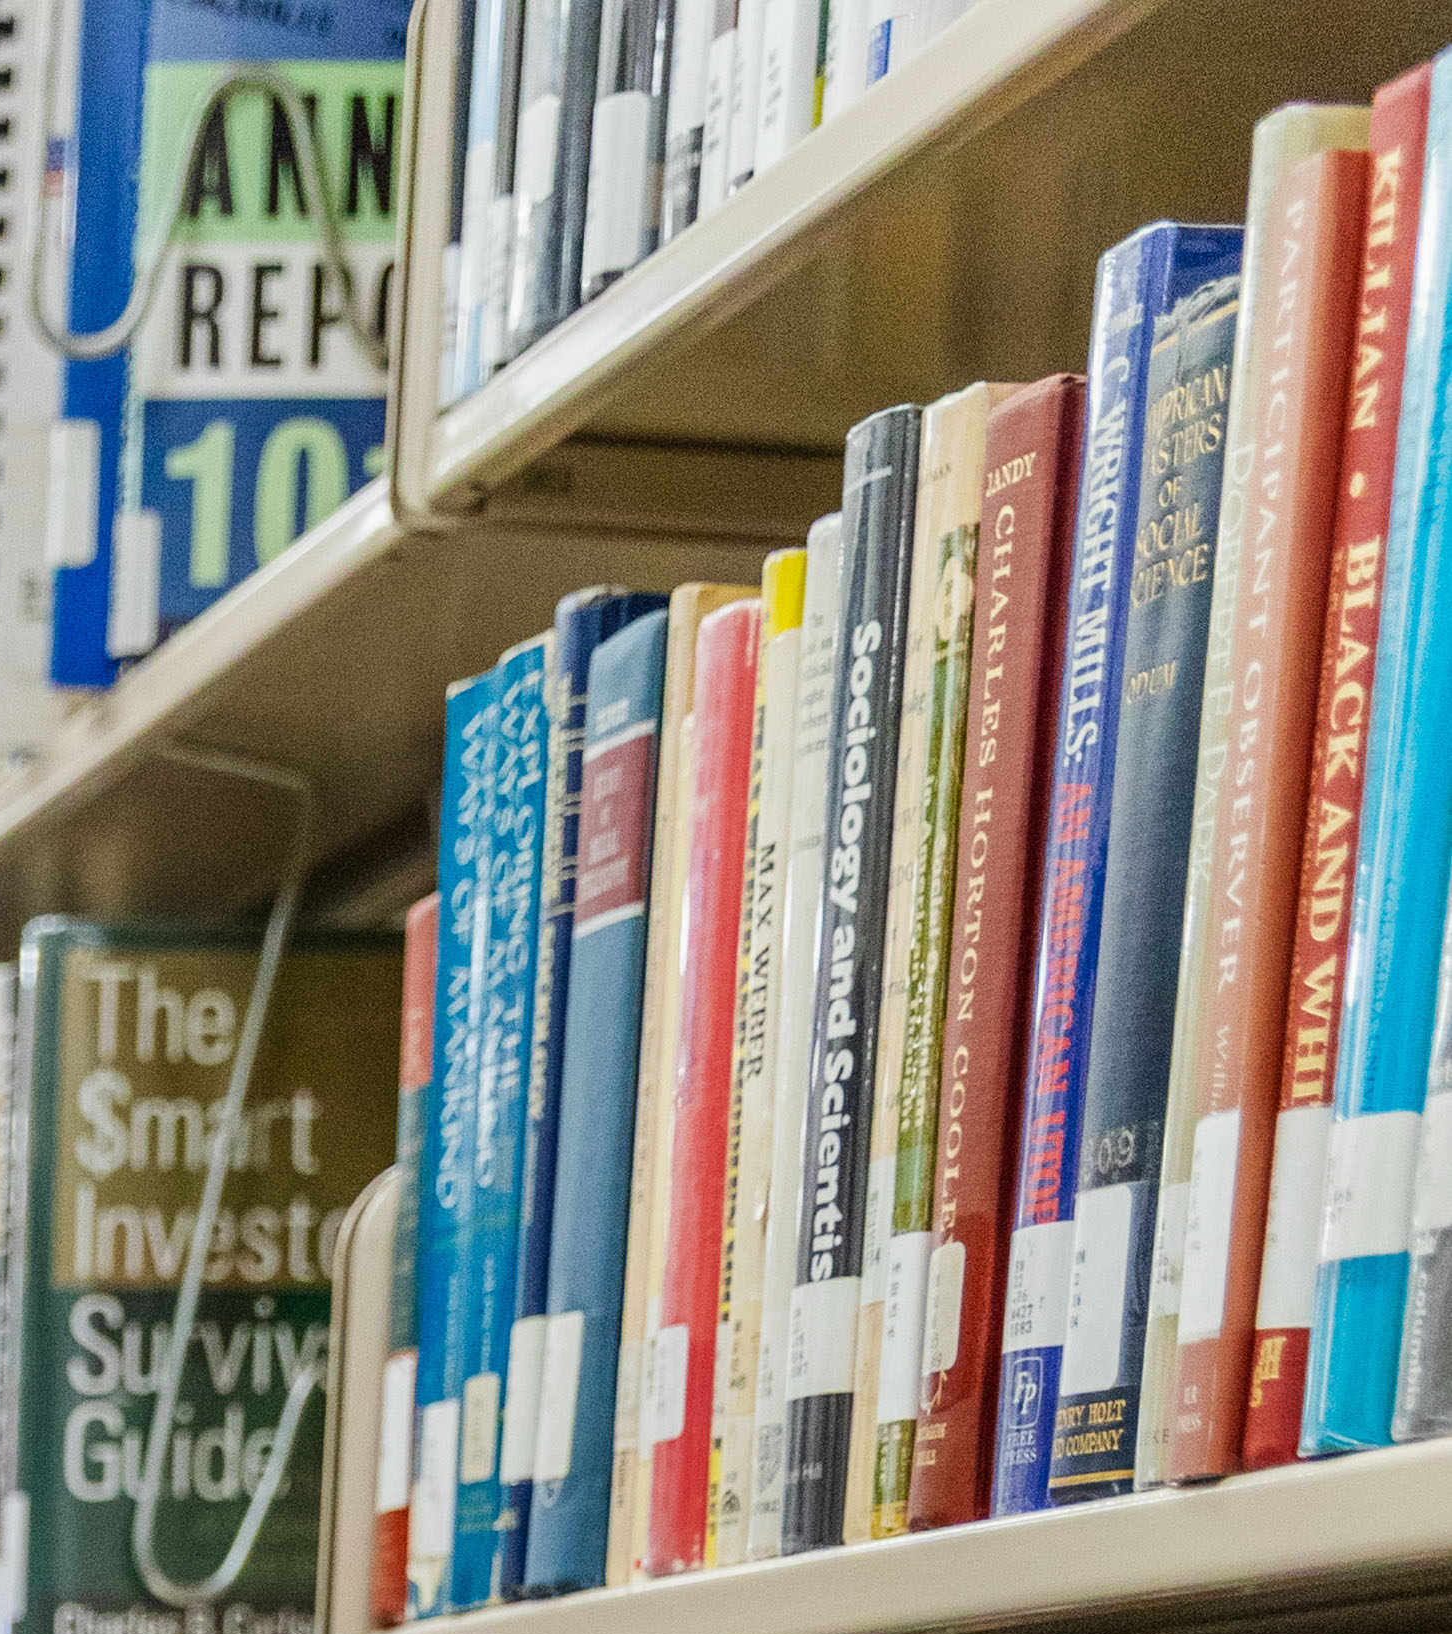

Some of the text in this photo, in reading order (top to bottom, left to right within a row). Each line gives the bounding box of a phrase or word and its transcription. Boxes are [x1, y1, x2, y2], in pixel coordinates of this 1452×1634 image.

[1243, 199, 1305, 635] PARTICIPANT
[1156, 473, 1186, 507] OF
[1308, 143, 1403, 943] KILLIAN BLACK AND
[978, 504, 1016, 767] CHARLES
[829, 619, 883, 915] Sociology
[1034, 400, 1127, 1096] WRIGHT MILLS: AN AMERICAN
[754, 840, 777, 930] MAX
[1215, 658, 1264, 997] OBSERVER
[955, 789, 993, 1023] HORTON
[75, 962, 238, 1067] The
[826, 922, 858, 1041] and
[75, 1070, 324, 1182] Smart
[61, 1401, 296, 1503] Guide
[1066, 1428, 1125, 1457] COMPANY
[1088, 1397, 1128, 1424] HOLT
